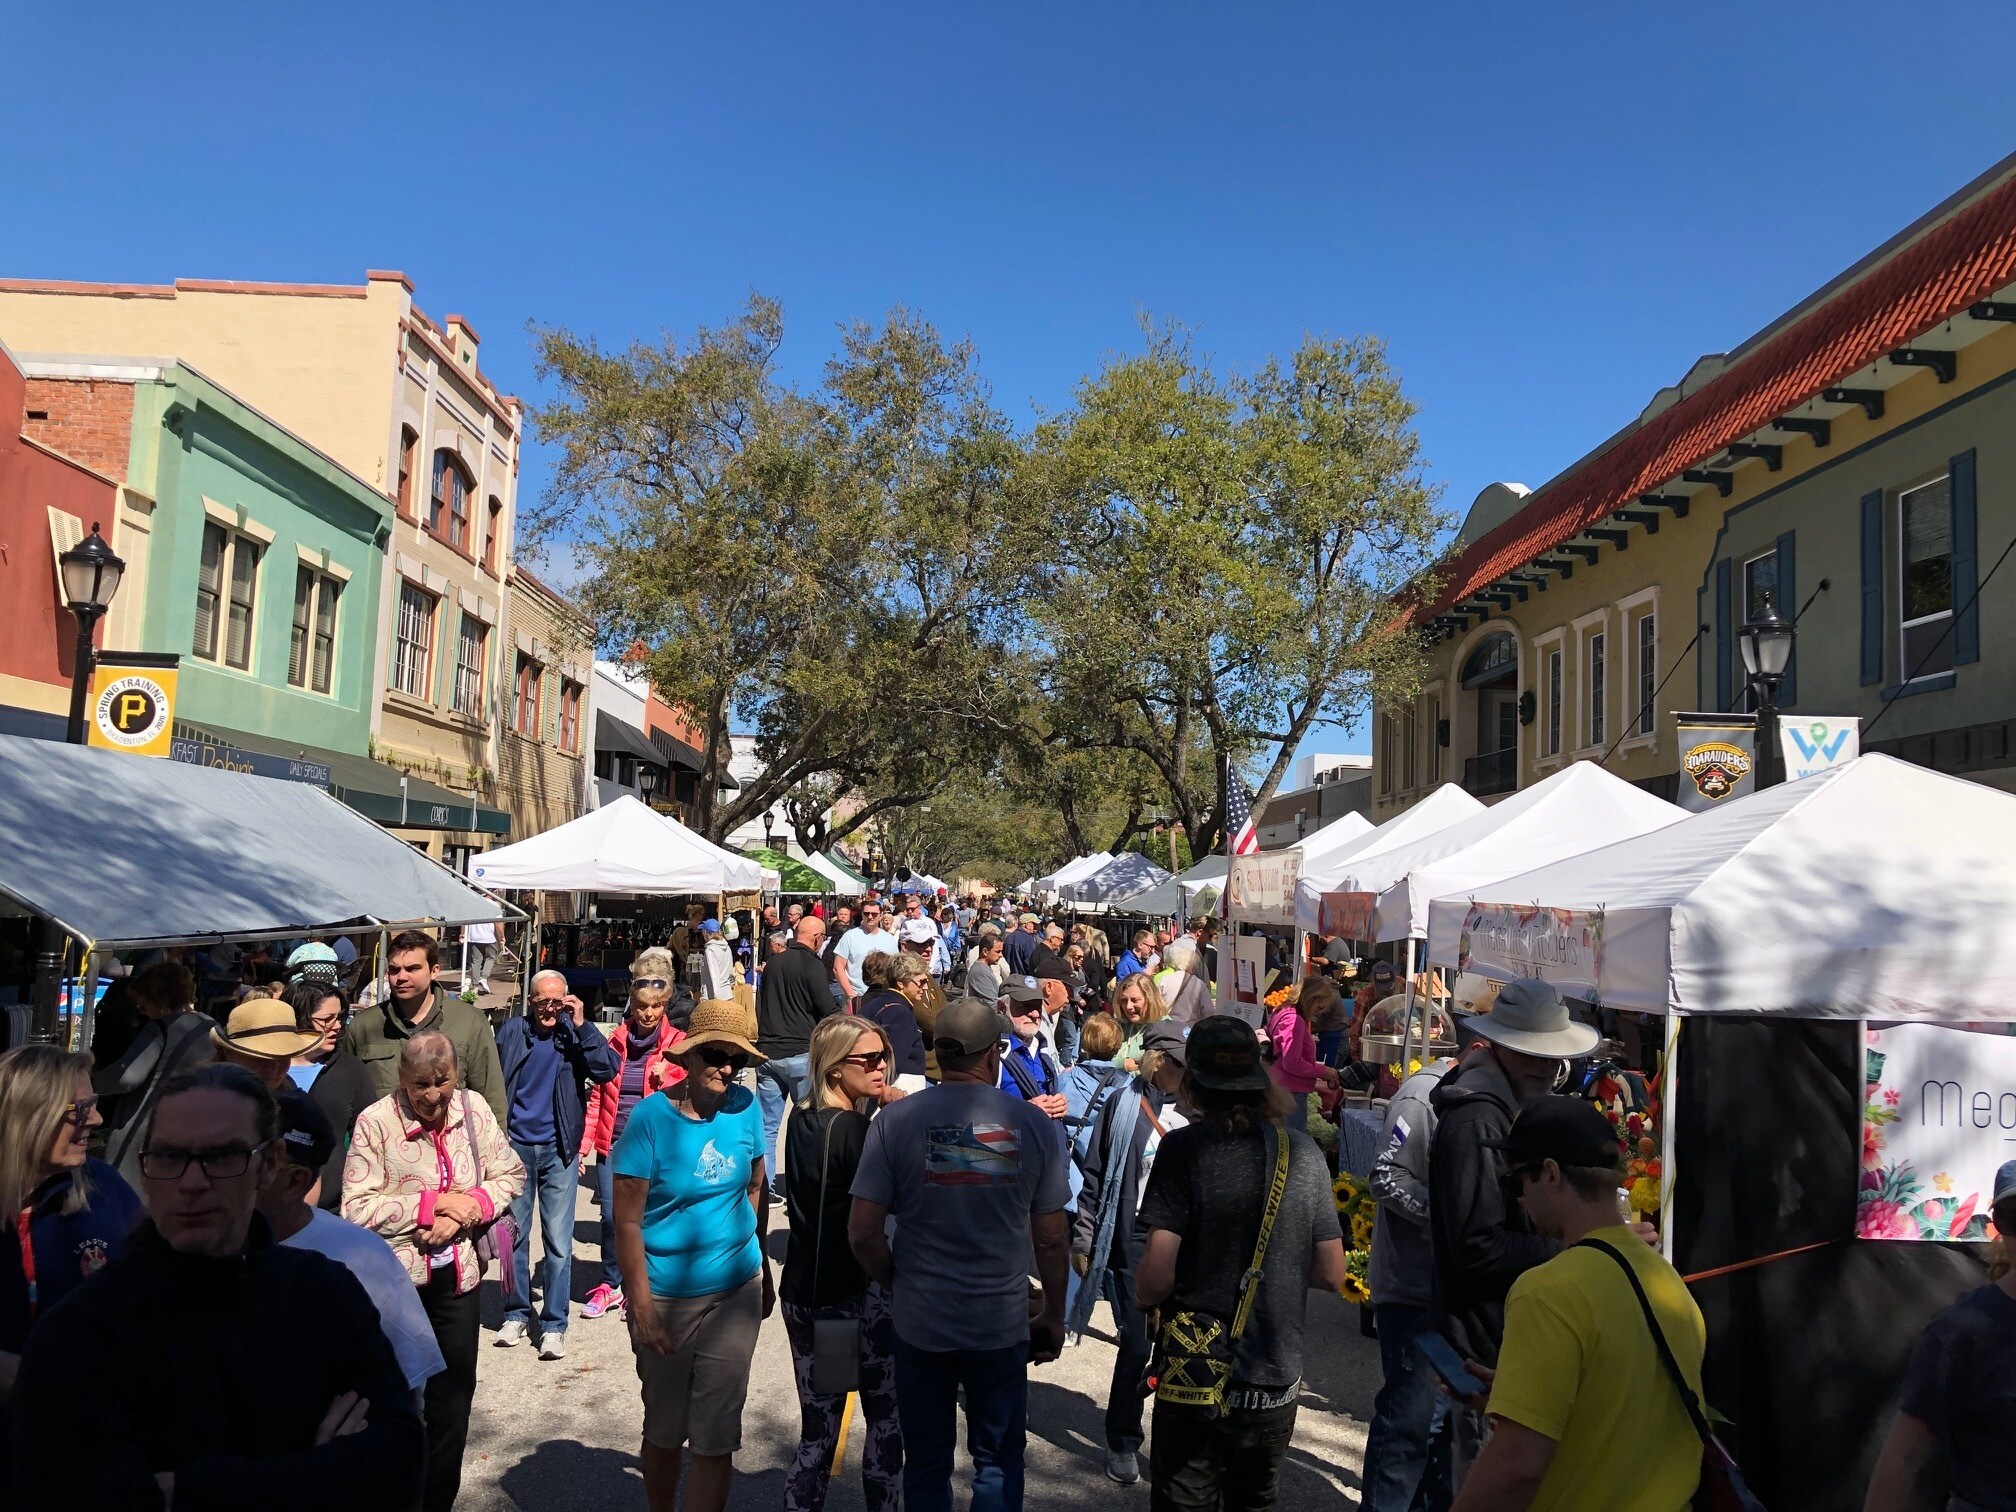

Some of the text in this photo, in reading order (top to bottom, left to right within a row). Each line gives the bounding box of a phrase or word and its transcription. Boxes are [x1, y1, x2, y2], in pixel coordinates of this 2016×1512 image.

[98, 679, 164, 719] SPRING TRAINING
[119, 695, 147, 728] P
[155, 715, 166, 731] 2020
[1689, 750, 1748, 771] MARAUDERS
[1257, 1164, 1287, 1254] OFF-WHITE
[1160, 1386, 1211, 1400] OFF-WHITE
